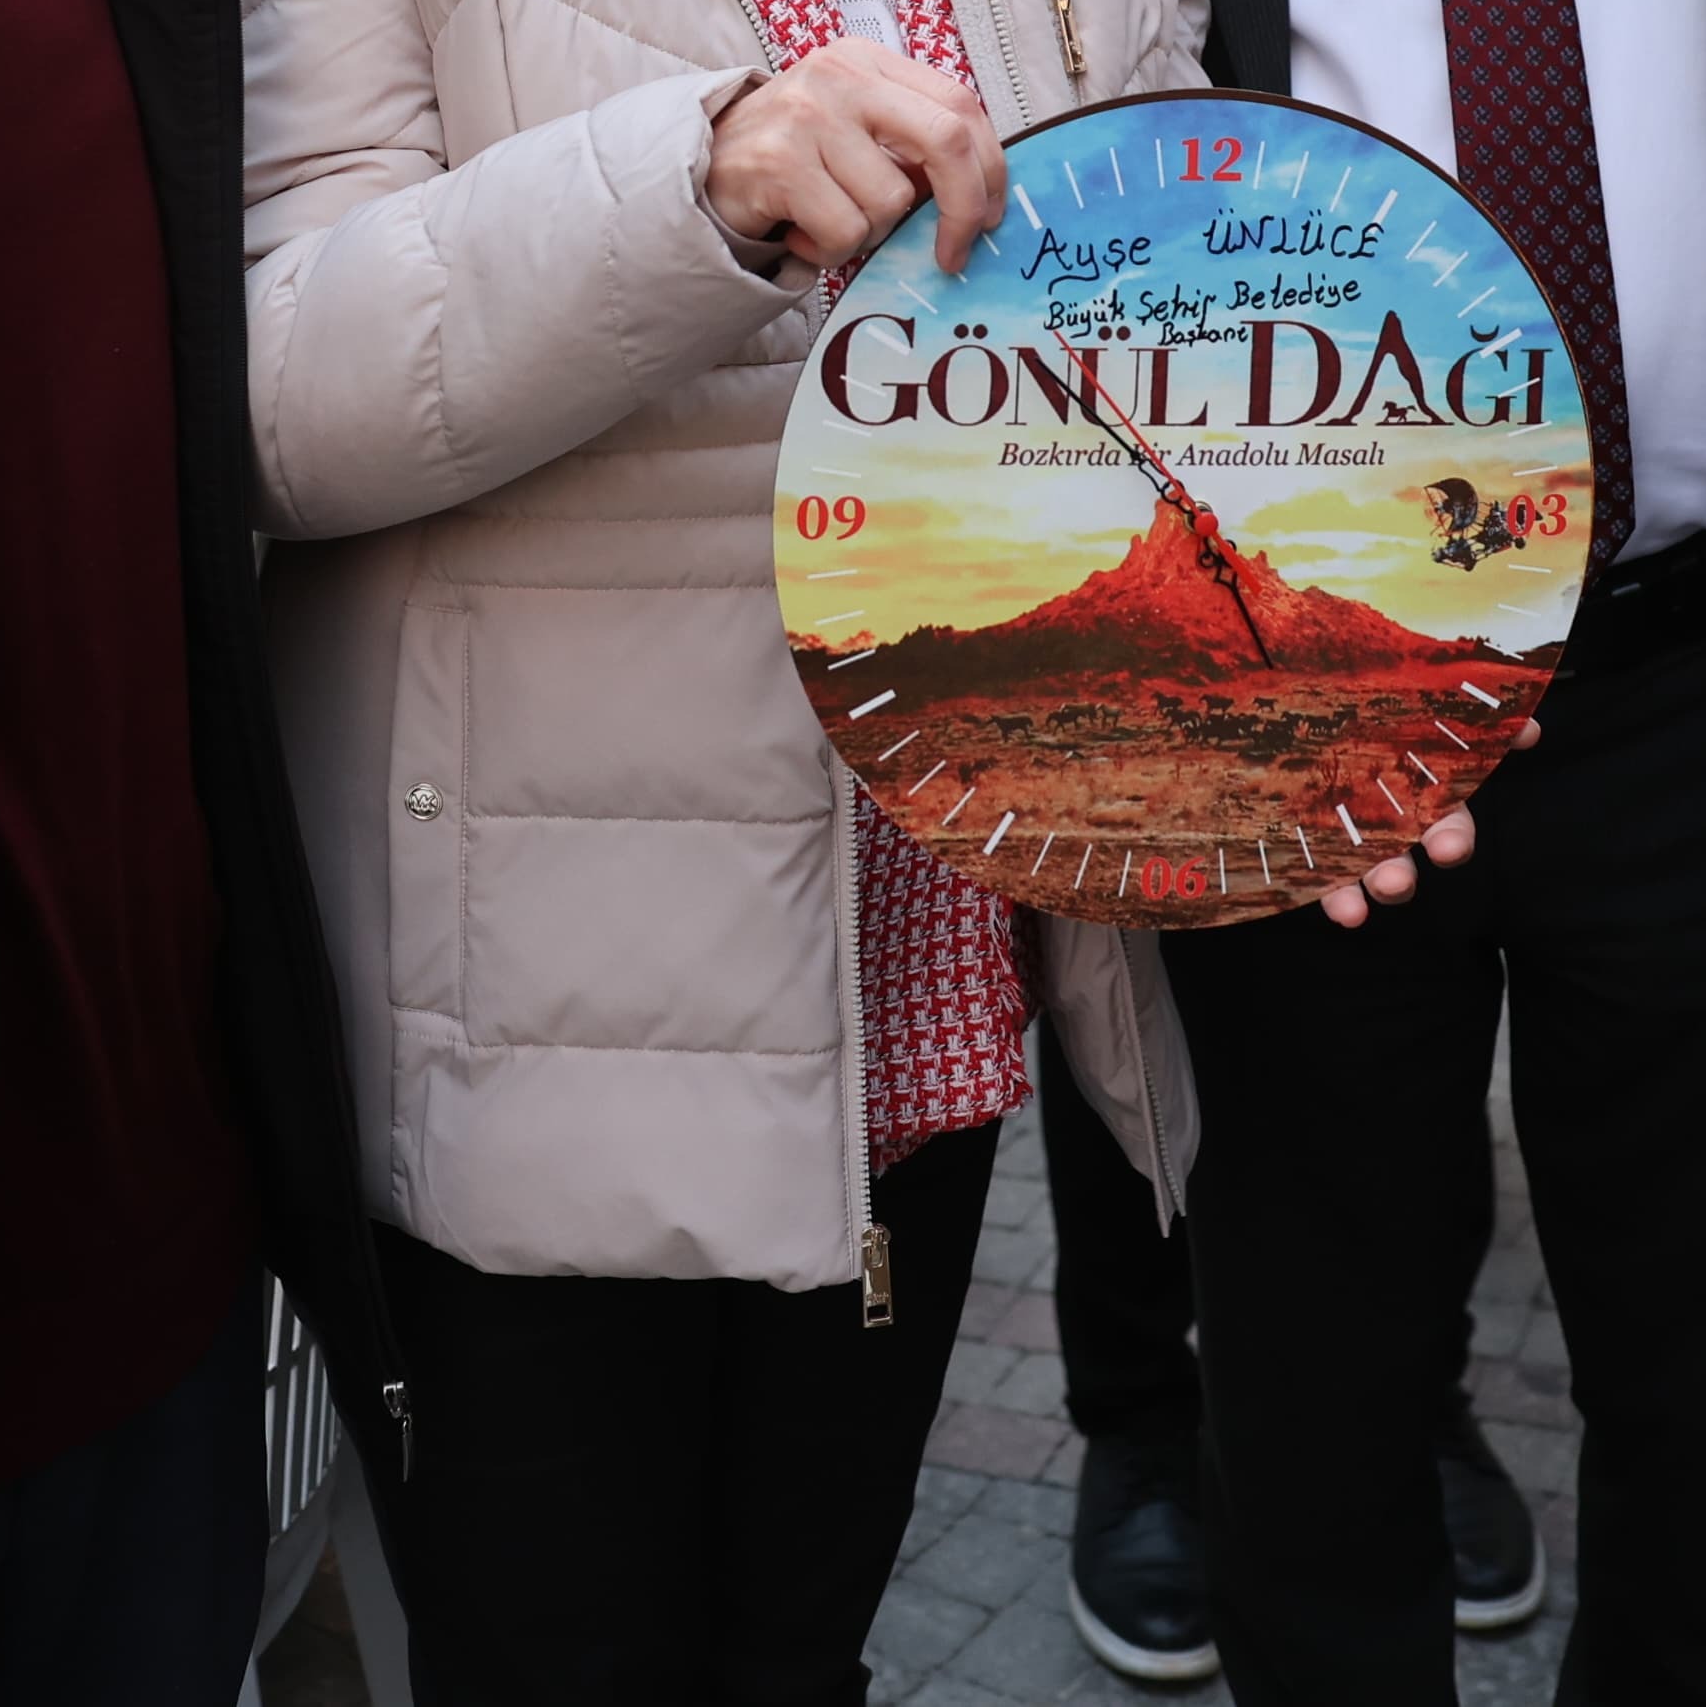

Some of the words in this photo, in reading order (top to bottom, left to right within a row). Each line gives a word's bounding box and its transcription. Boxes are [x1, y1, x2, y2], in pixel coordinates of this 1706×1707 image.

[1179, 137, 1242, 182] 12
[1020, 227, 1152, 295] Ayşe
[1203, 208, 1384, 259] ÜNLÜCE
[1044, 289, 1125, 339] Büyük
[820, 314, 1208, 427] GÖNÜL
[1235, 310, 1554, 427] DAĞI
[998, 441, 1121, 467] Bozkırda
[1175, 441, 1289, 467] Anadolu
[1294, 441, 1386, 467] Masalı
[796, 495, 867, 541] 09
[1507, 494, 1567, 537] 03
[1141, 856, 1207, 900] 06
